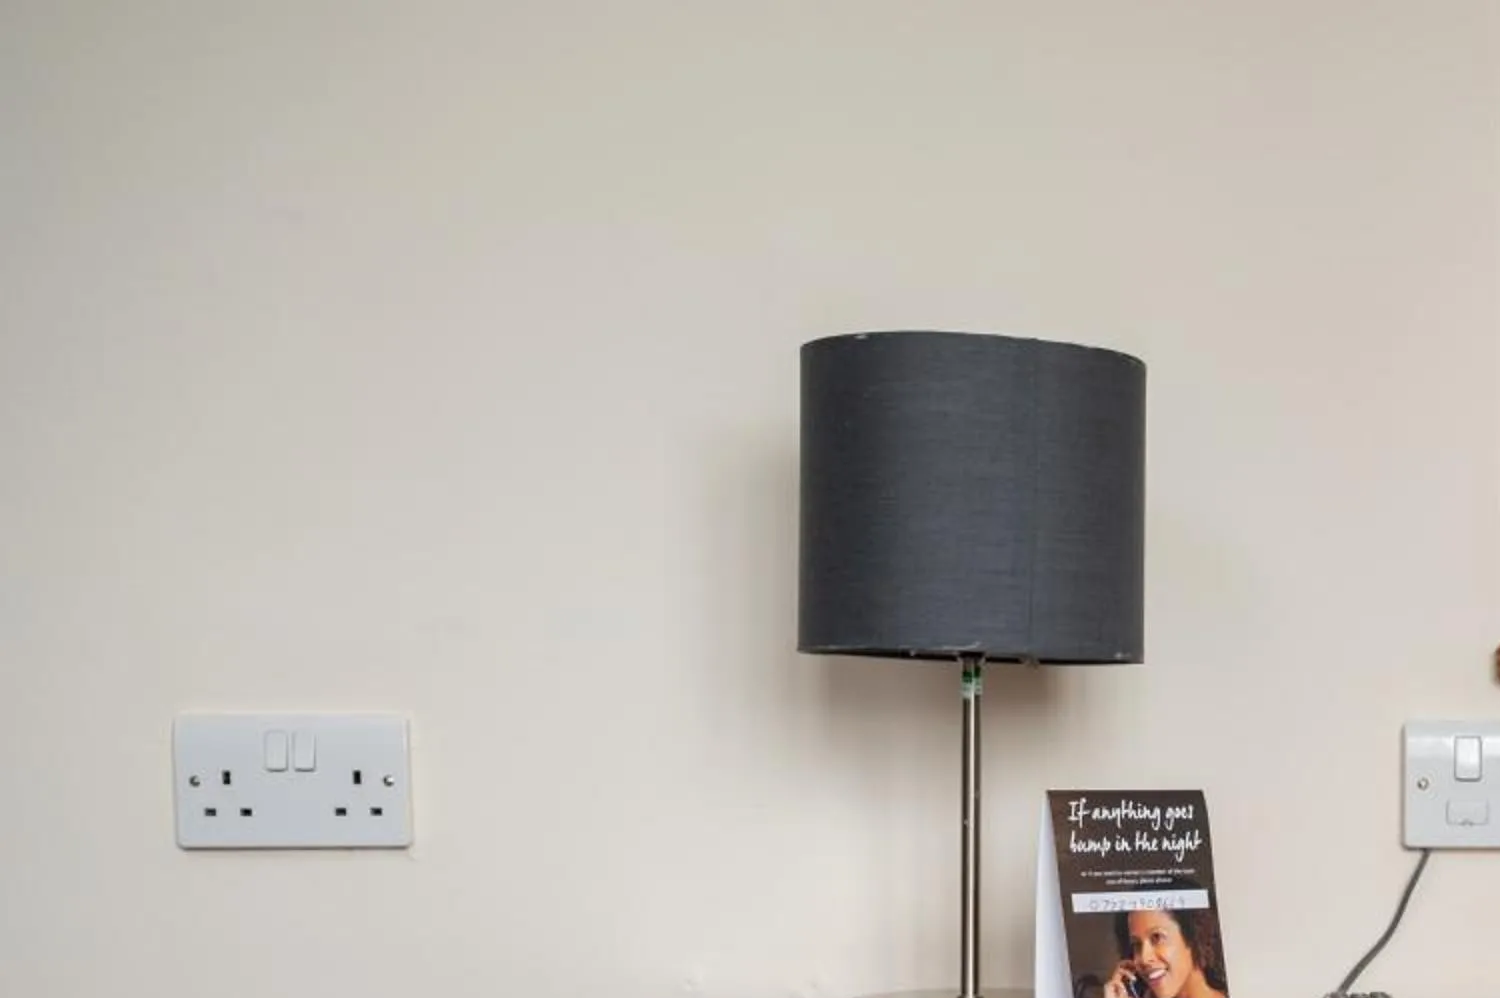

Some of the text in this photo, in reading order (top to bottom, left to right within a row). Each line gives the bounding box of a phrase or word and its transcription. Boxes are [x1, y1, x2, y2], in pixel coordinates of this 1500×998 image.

[1068, 797, 1194, 830] If anything goes
[1069, 829, 1202, 863] bump in the night
